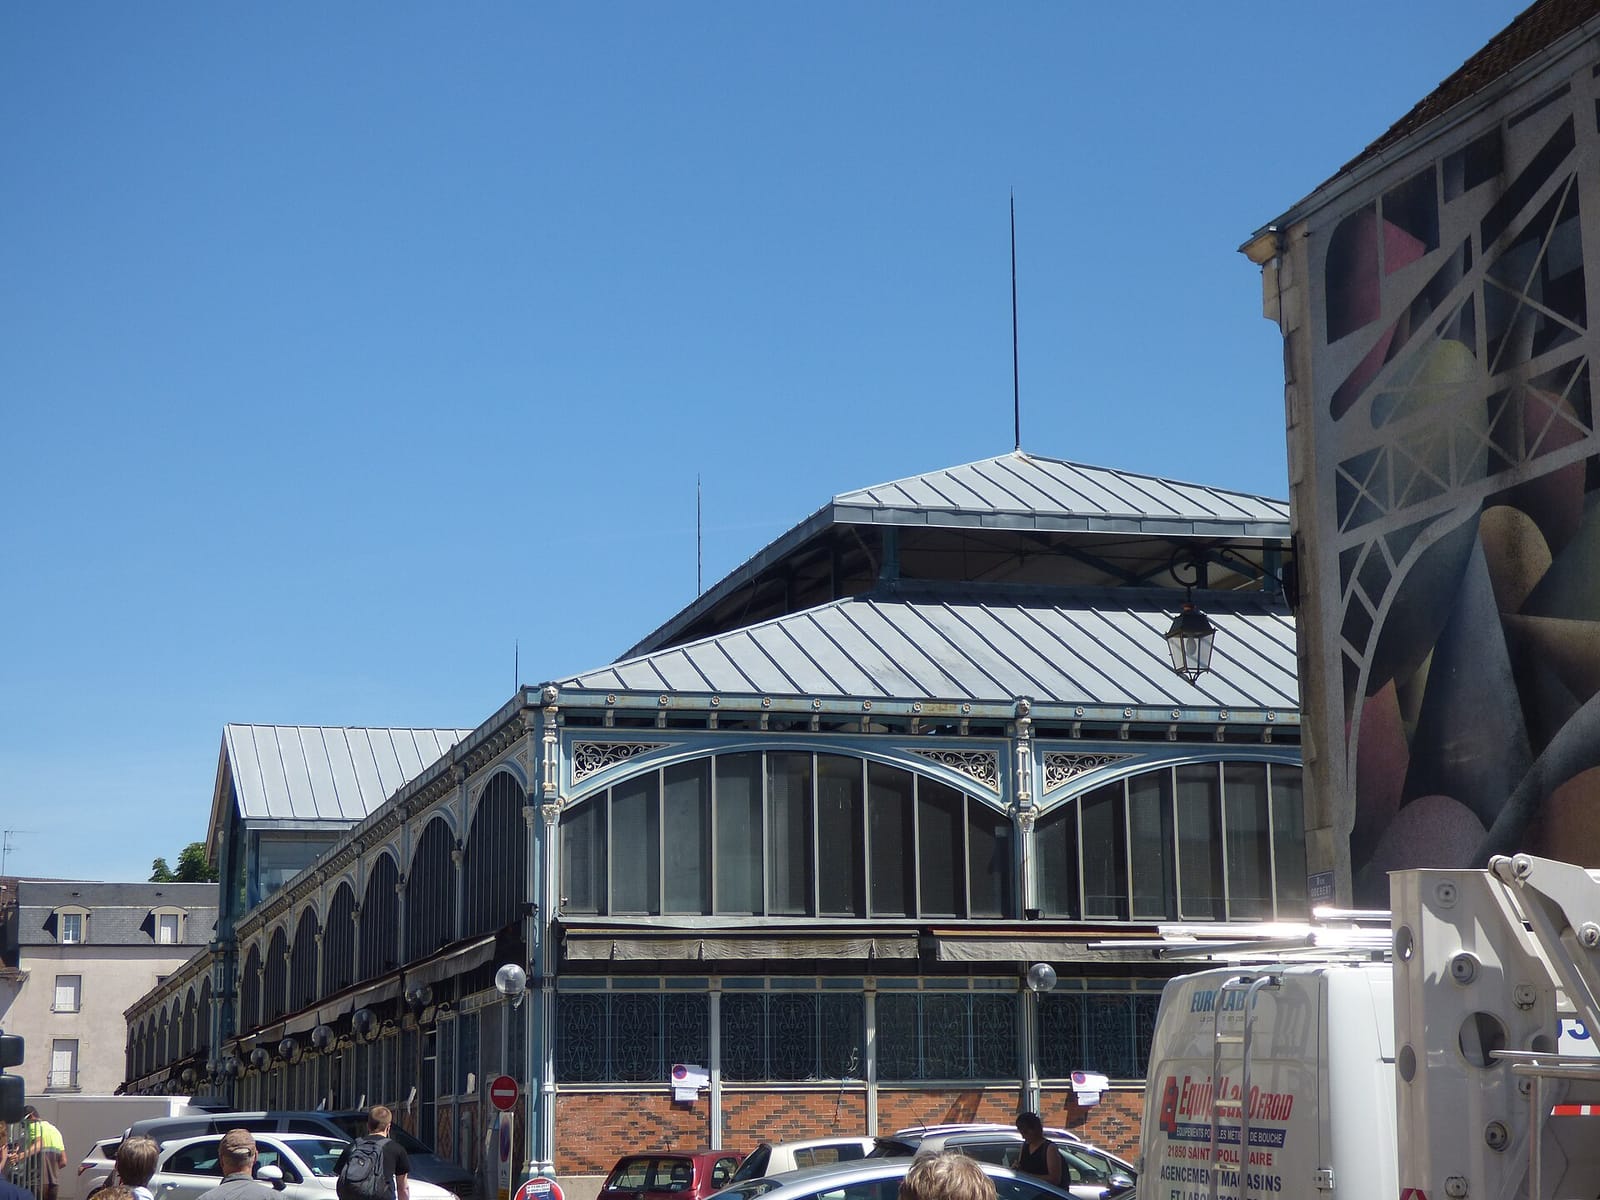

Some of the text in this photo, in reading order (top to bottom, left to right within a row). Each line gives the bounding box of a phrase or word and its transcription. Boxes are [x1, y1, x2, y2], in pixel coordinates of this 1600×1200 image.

[1249, 1131, 1258, 1142] DE
[1258, 1132, 1282, 1144] BOUCHE
[1168, 1145, 1272, 1166] 21850 SAINT POLLAIRE
[1160, 1165, 1212, 1185] AGENCEMEN
